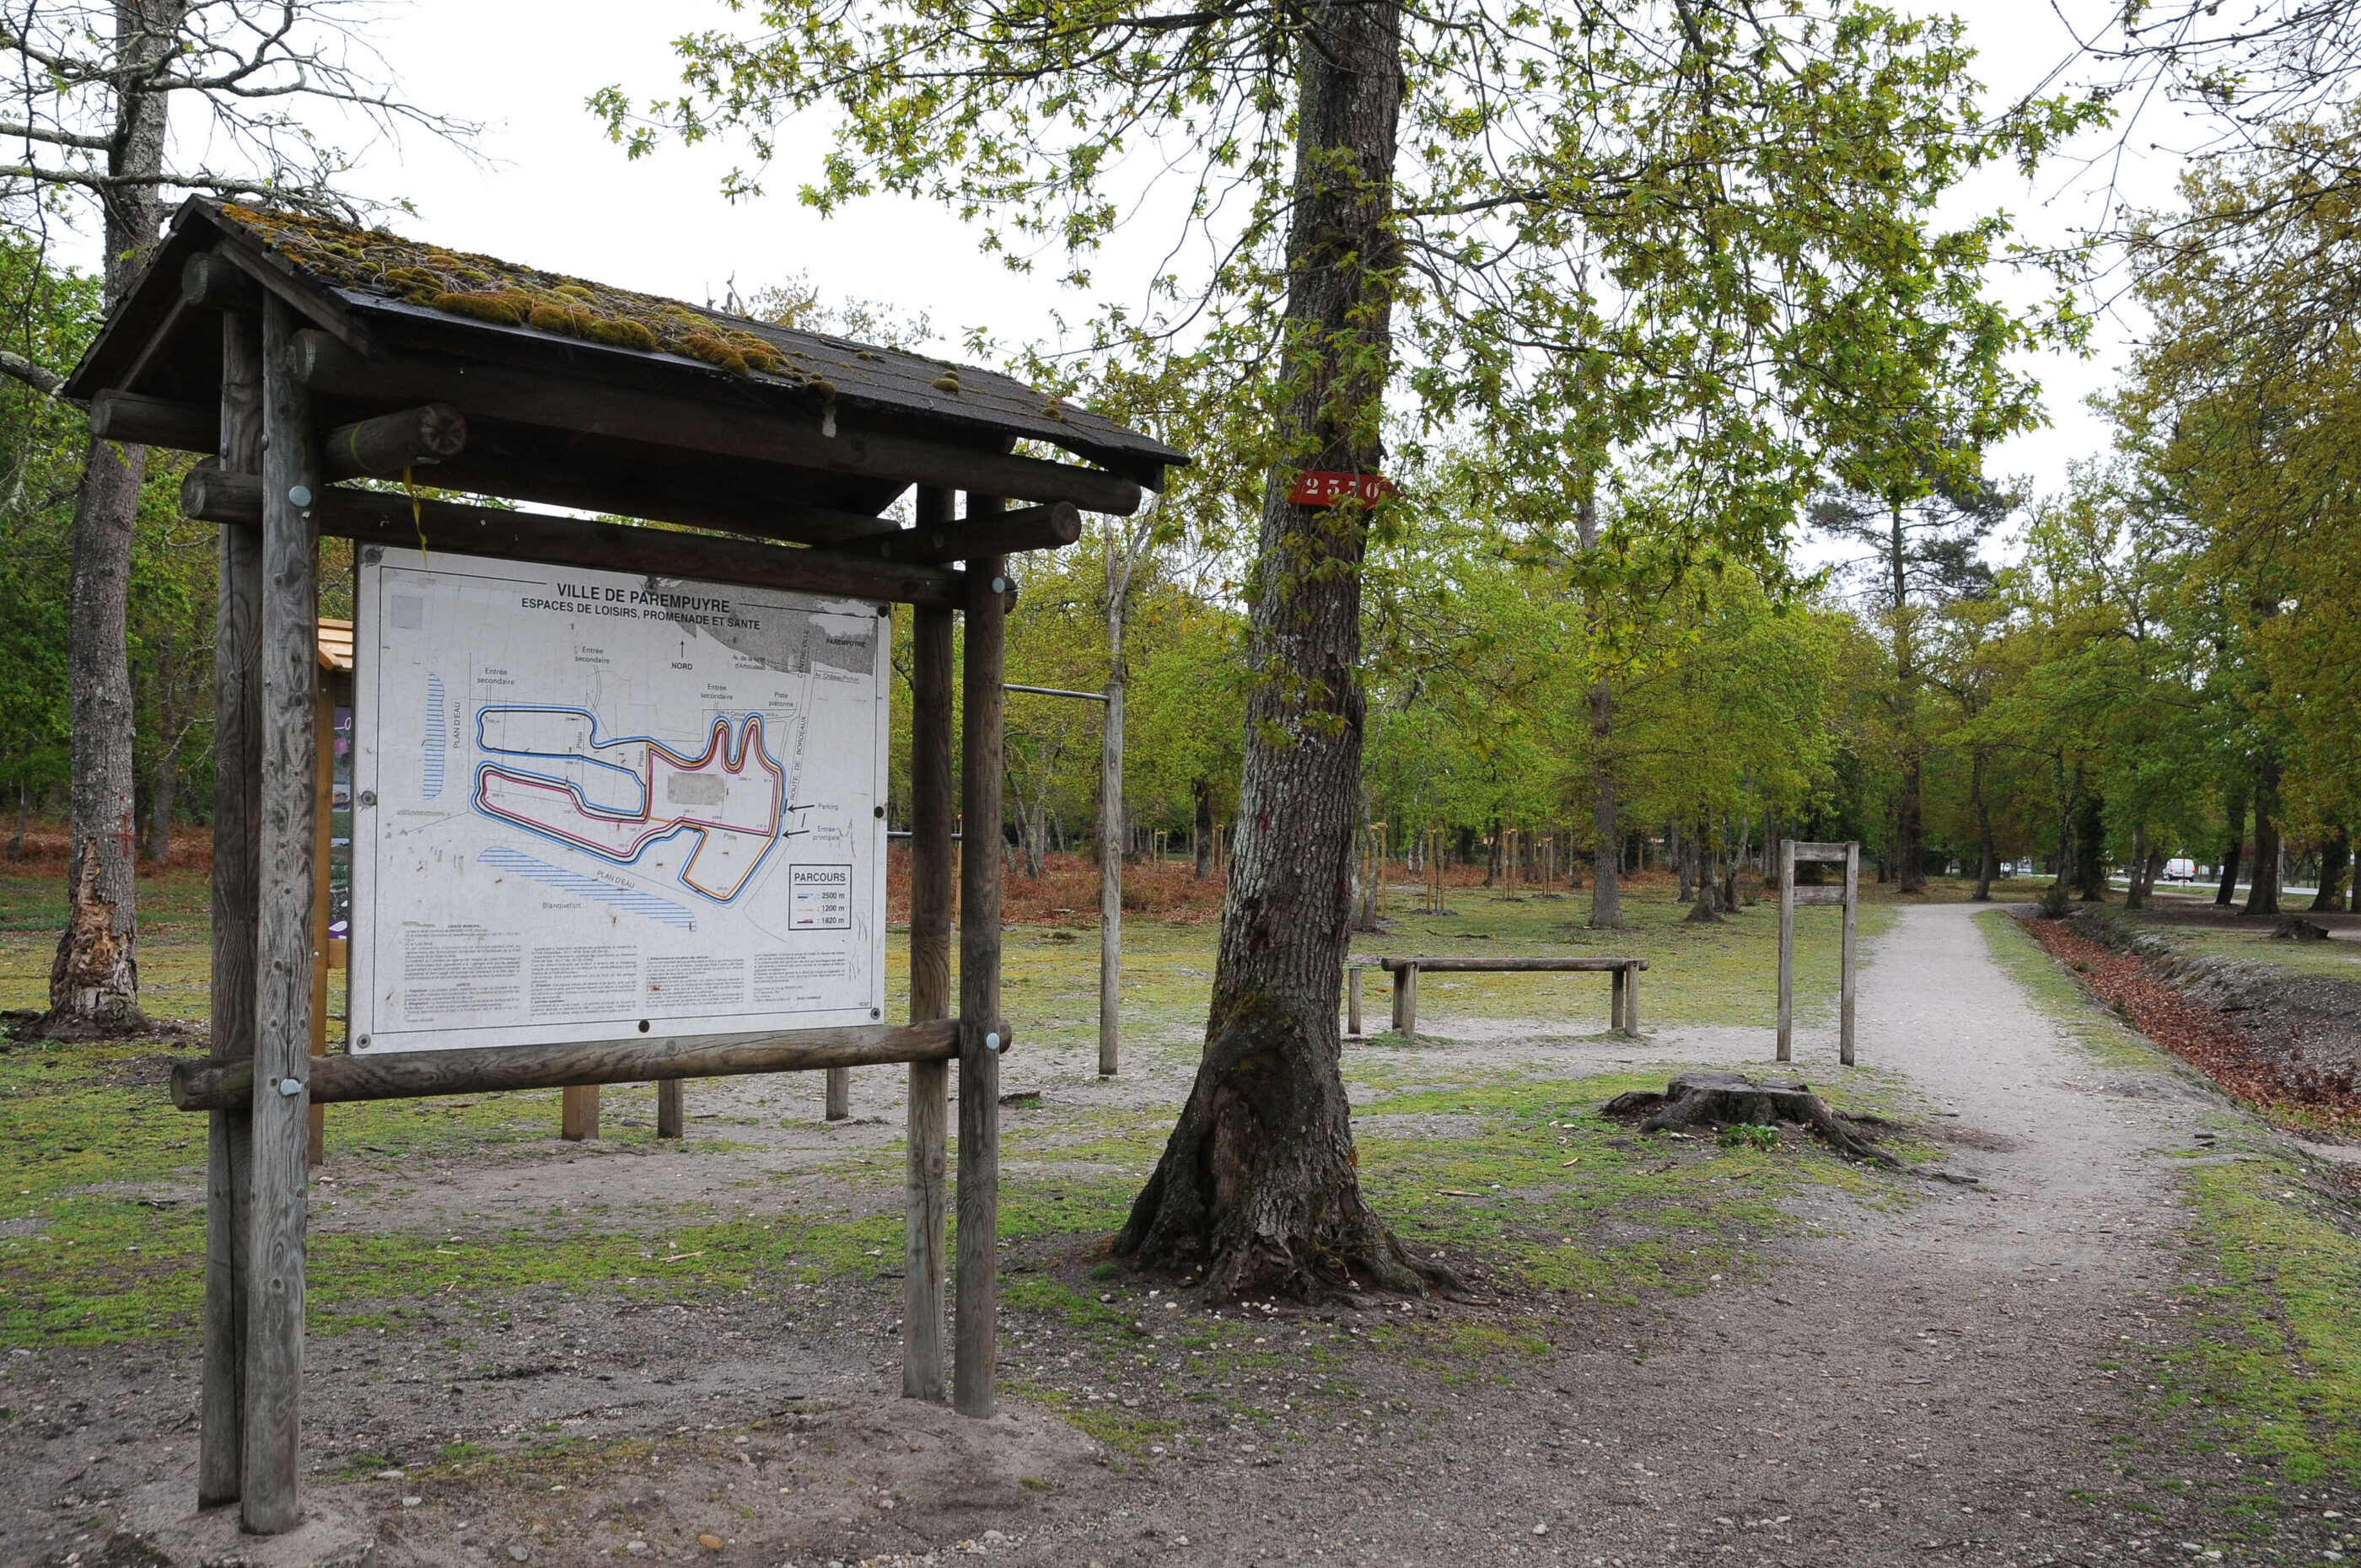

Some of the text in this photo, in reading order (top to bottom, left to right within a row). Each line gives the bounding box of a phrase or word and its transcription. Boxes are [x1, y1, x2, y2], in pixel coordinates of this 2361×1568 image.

[557, 583, 730, 614] VILLE DE PAREMPUYRE
[521, 598, 761, 630] ESPACES DE LOISIRS, PROMENADE ET SANTE
[826, 638, 866, 648] PAREMPUYRE
[582, 646, 604, 654] Entrée
[574, 655, 610, 664] secondaire
[671, 662, 693, 670] NORD
[485, 667, 508, 675] Entrée
[476, 677, 515, 685] secondaire
[707, 683, 727, 691] Entrée
[701, 692, 733, 701] secondaire
[768, 699, 794, 708] piétonne
[797, 716, 807, 755] BORDEAUX
[794, 760, 801, 771] DE
[723, 832, 738, 840] Piste
[812, 834, 841, 842] principale
[596, 870, 635, 889] PLAN D'EAU
[794, 873, 846, 882] PARCOURS
